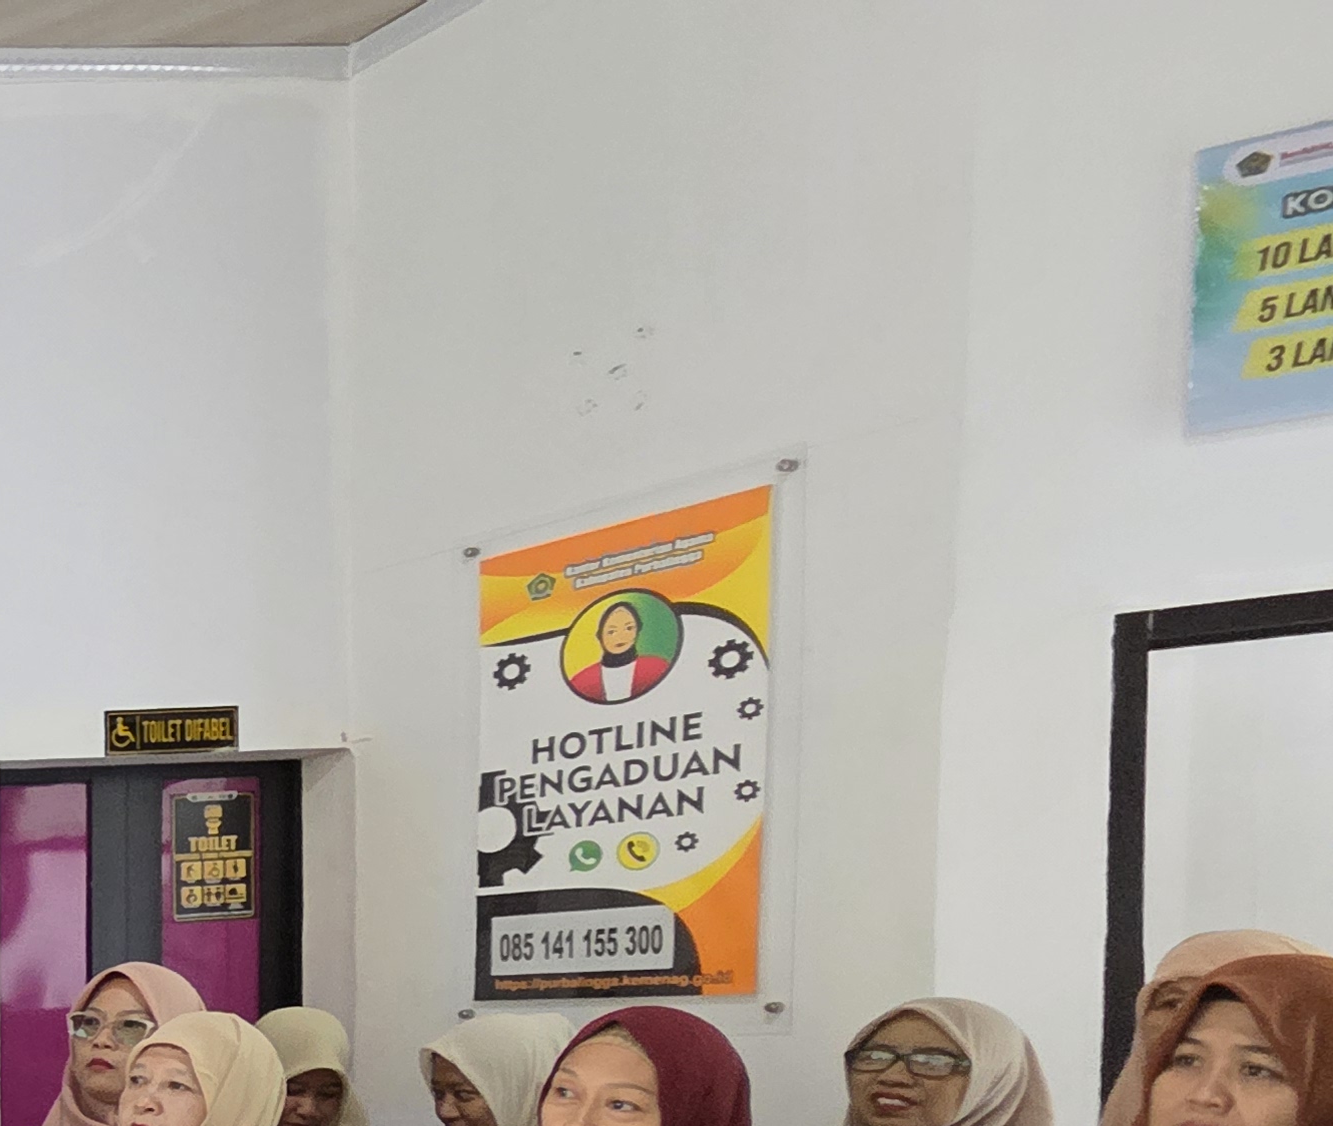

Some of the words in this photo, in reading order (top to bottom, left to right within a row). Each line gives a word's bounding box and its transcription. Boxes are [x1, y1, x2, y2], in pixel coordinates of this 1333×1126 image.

[1257, 240, 1292, 272] 10
[1258, 295, 1279, 323] 5
[1265, 344, 1286, 373] 3
[1291, 334, 1333, 368] LA
[141, 719, 183, 743] TOILET
[184, 717, 233, 742] DIFABEL
[531, 711, 703, 764] HOTLINE
[498, 743, 742, 803] PENGADUAN
[526, 785, 705, 833] LAYANAN
[187, 834, 238, 852] TOILET
[499, 933, 534, 962] 085
[540, 929, 575, 960] 141
[583, 927, 619, 958] 155
[625, 924, 663, 957] 300
